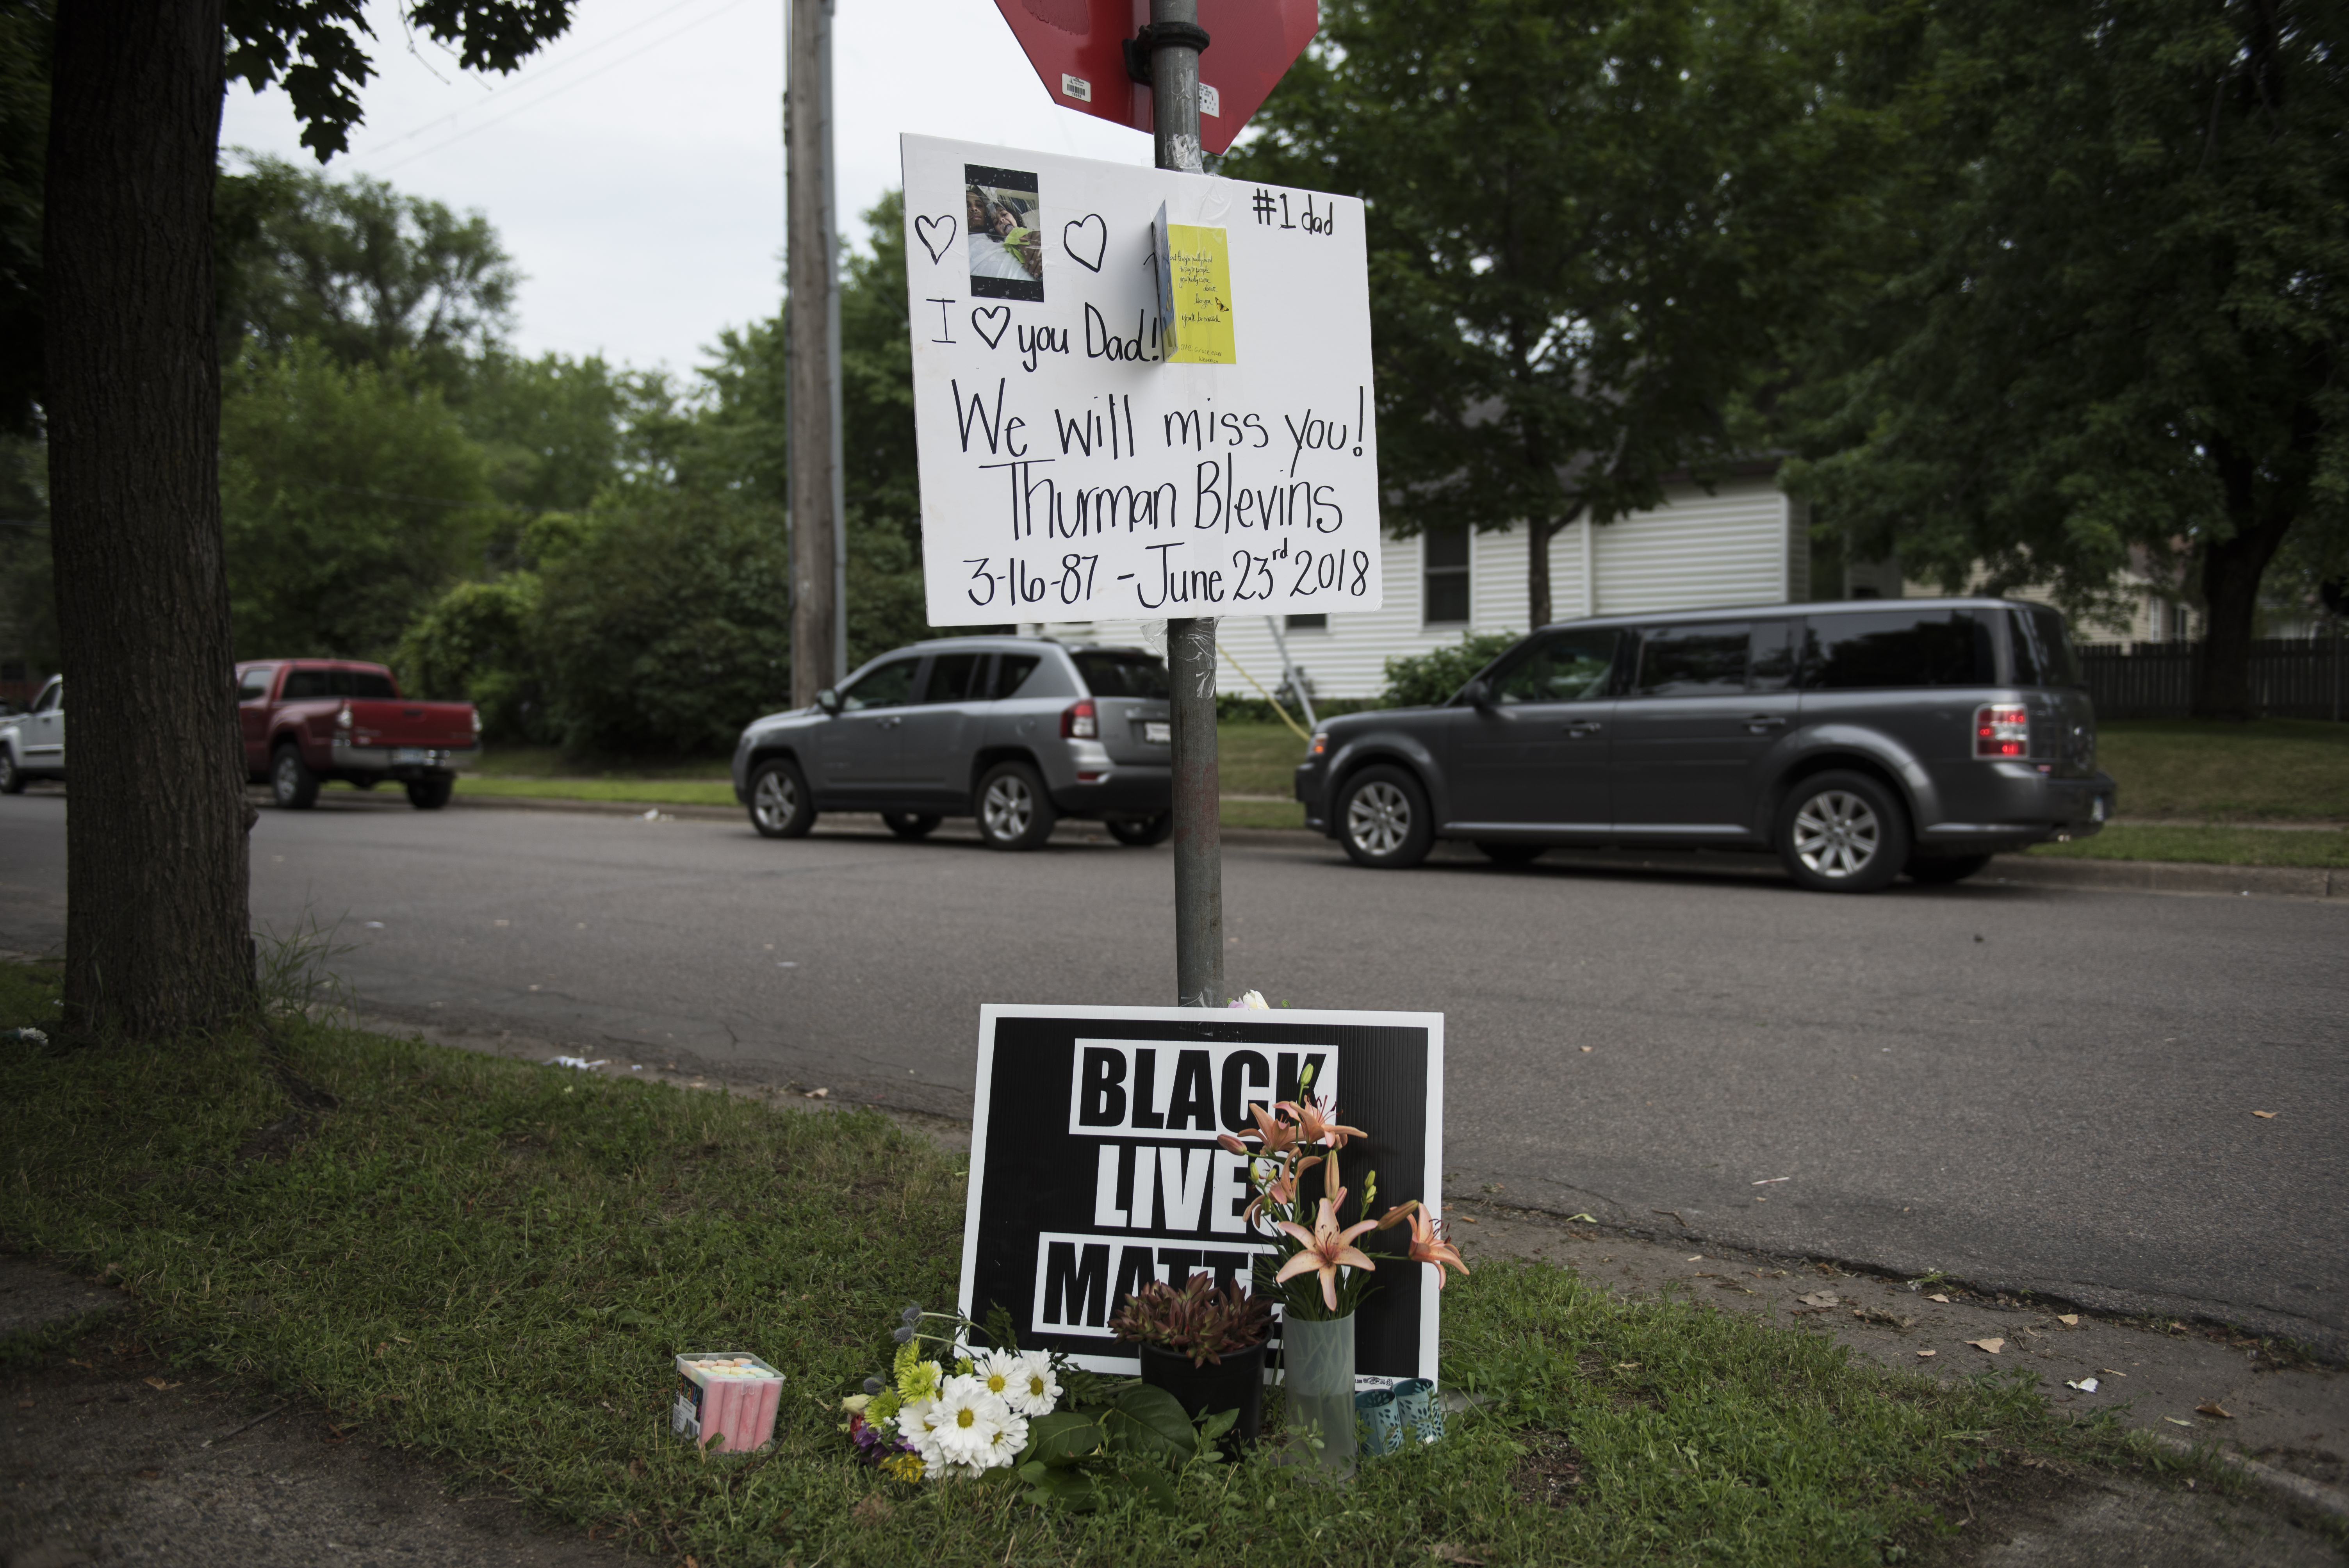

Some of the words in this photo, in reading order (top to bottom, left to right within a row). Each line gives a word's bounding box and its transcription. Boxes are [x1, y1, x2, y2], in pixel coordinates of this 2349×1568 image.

[1253, 188, 1296, 229] #1
[1301, 193, 1334, 236] dad
[1179, 277, 1187, 289] you
[1196, 265, 1210, 277] people
[1194, 292, 1203, 305] like
[1201, 299, 1213, 310] you
[1203, 284, 1218, 292] about
[1197, 311, 1203, 323] be
[1204, 314, 1221, 323] missed
[926, 298, 957, 344] I
[1018, 324, 1069, 373] you
[1084, 301, 1159, 362] Dad!
[1194, 346, 1210, 355] Grace
[951, 377, 1028, 458] We
[1054, 393, 1134, 460] will
[1164, 397, 1269, 452] miss
[1284, 385, 1364, 478] you!
[978, 458, 1176, 541] Thurman
[1194, 452, 1343, 535] Blevins
[963, 554, 1099, 606] 3-16-87
[1137, 542, 1224, 609] June
[1232, 537, 1289, 601] 23rd
[1289, 549, 1369, 597] 2018
[1078, 1046, 1327, 1135] BLACK
[680, 1379, 698, 1406] Chalk
